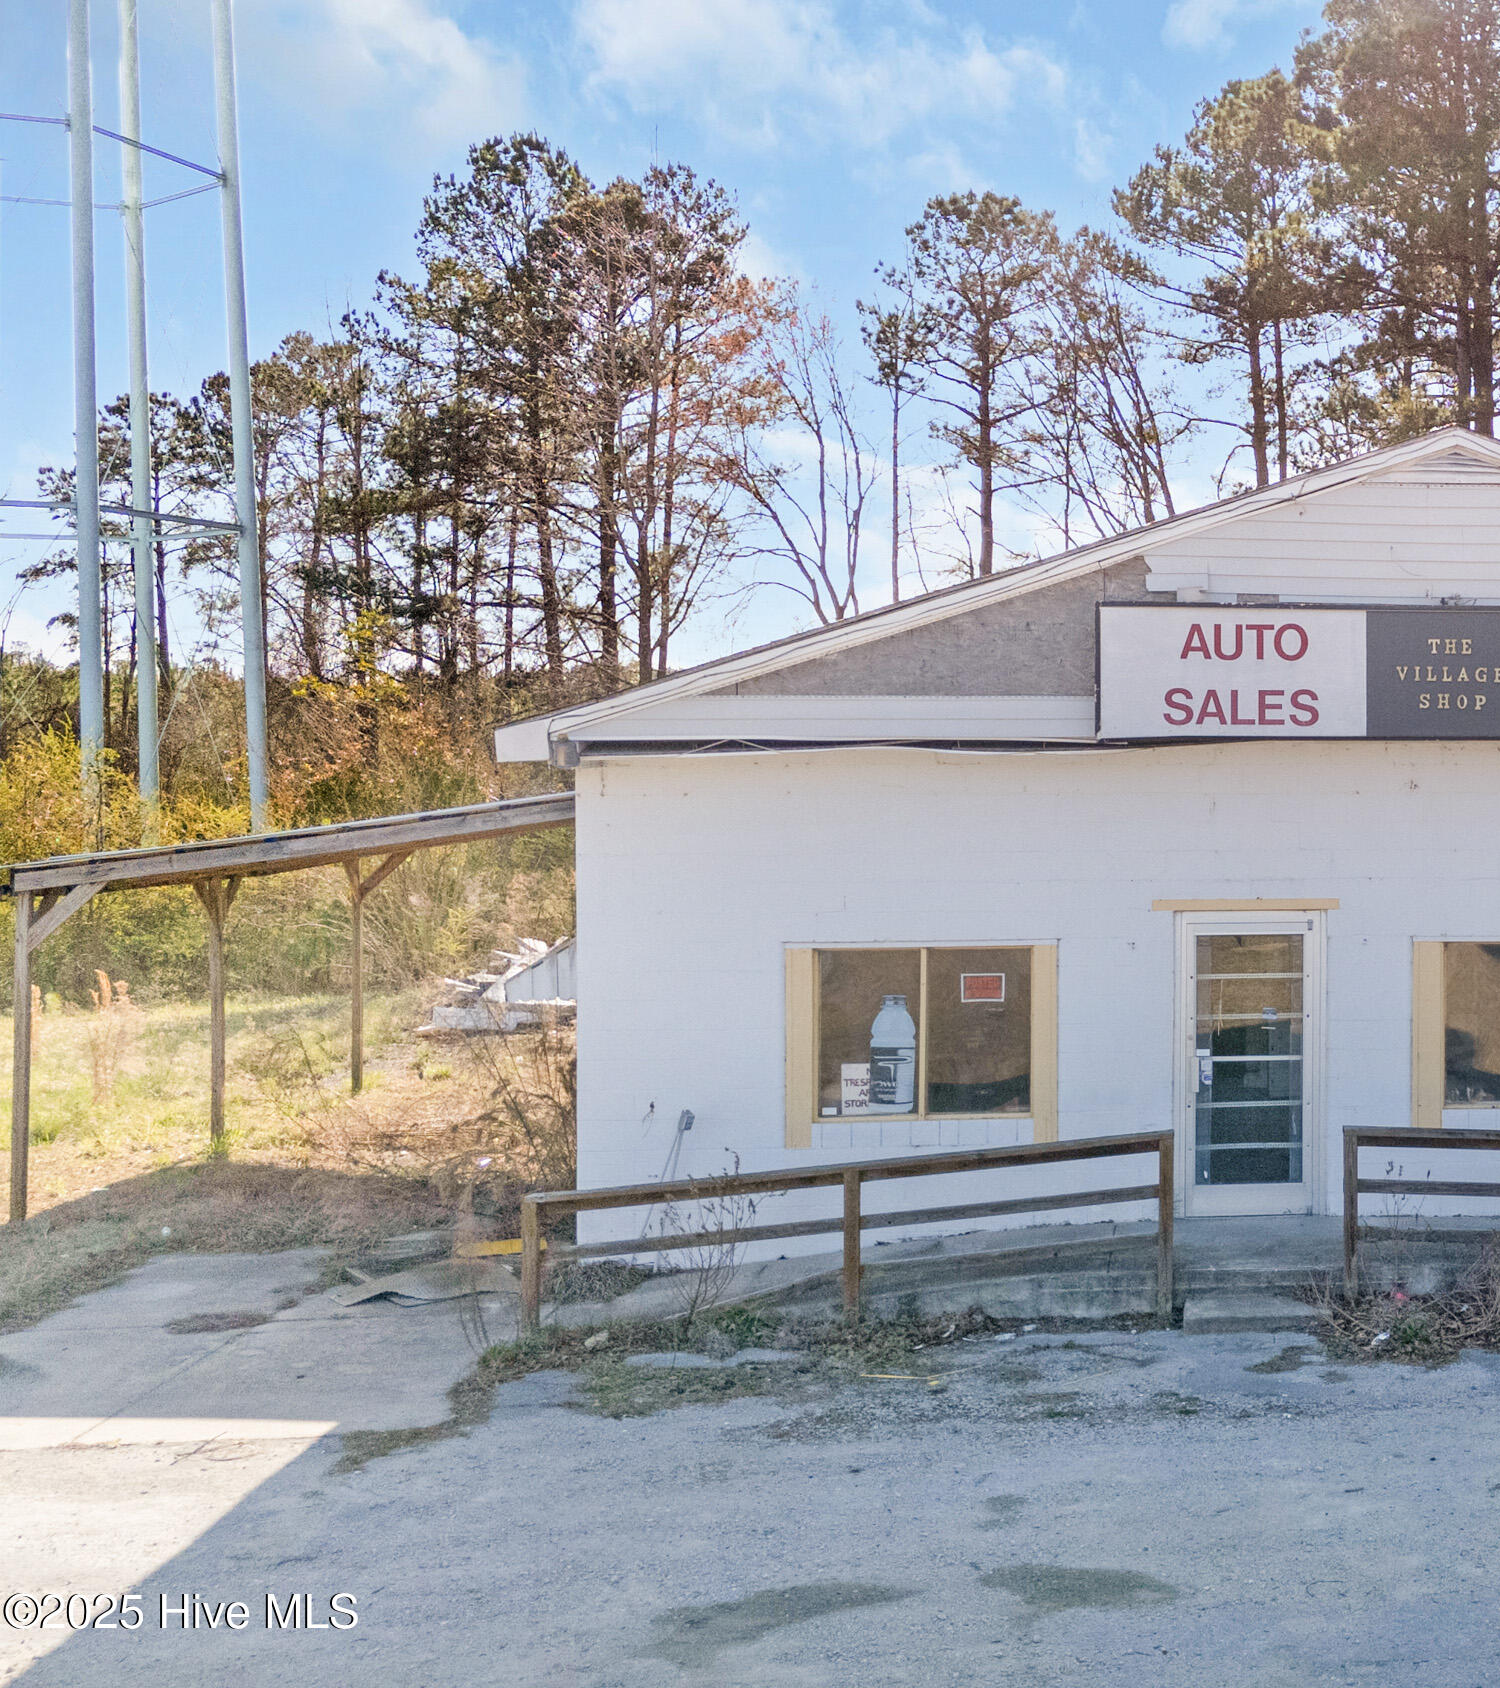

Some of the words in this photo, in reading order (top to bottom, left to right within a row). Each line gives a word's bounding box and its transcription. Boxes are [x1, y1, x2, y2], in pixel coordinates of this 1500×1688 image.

[1180, 623, 1309, 661] AUTO
[1428, 638, 1472, 655] THE
[1163, 687, 1320, 726] SALES
[1419, 693, 1487, 711] SHOP
[843, 1099, 869, 1108] STOR
